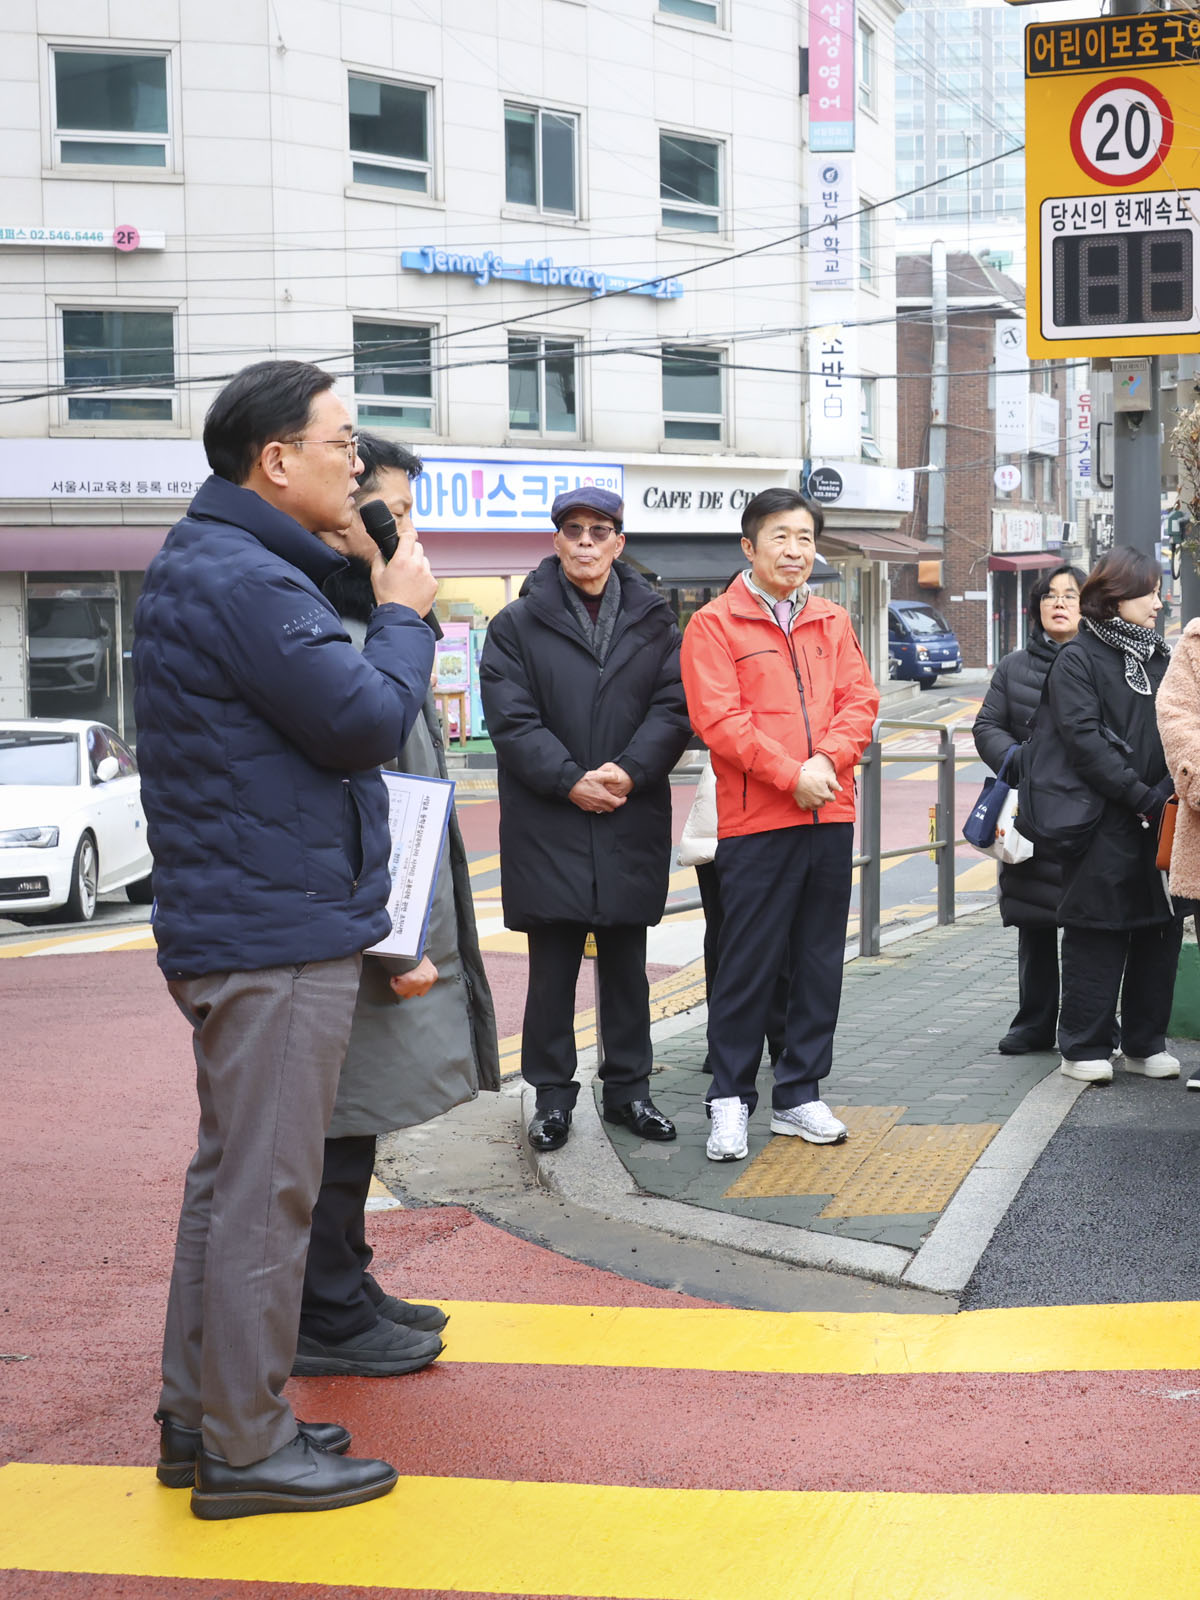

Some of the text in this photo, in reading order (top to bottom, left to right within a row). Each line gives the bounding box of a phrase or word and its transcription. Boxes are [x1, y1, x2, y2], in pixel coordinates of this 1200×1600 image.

[818, 1, 841, 109] 삼성영어
[1094, 101, 1151, 162] 20
[1050, 196, 1194, 232] 당신의 현재속도
[30, 230, 104, 242] 02.546.5446
[117, 231, 135, 244] 2F
[421, 247, 607, 297] Jenny's Library
[654, 278, 679, 299] 2F
[51, 480, 131, 493] 서울시교육청
[136, 480, 162, 493] 등록
[643, 486, 692, 510] CAFE
[698, 491, 723, 510] DE
